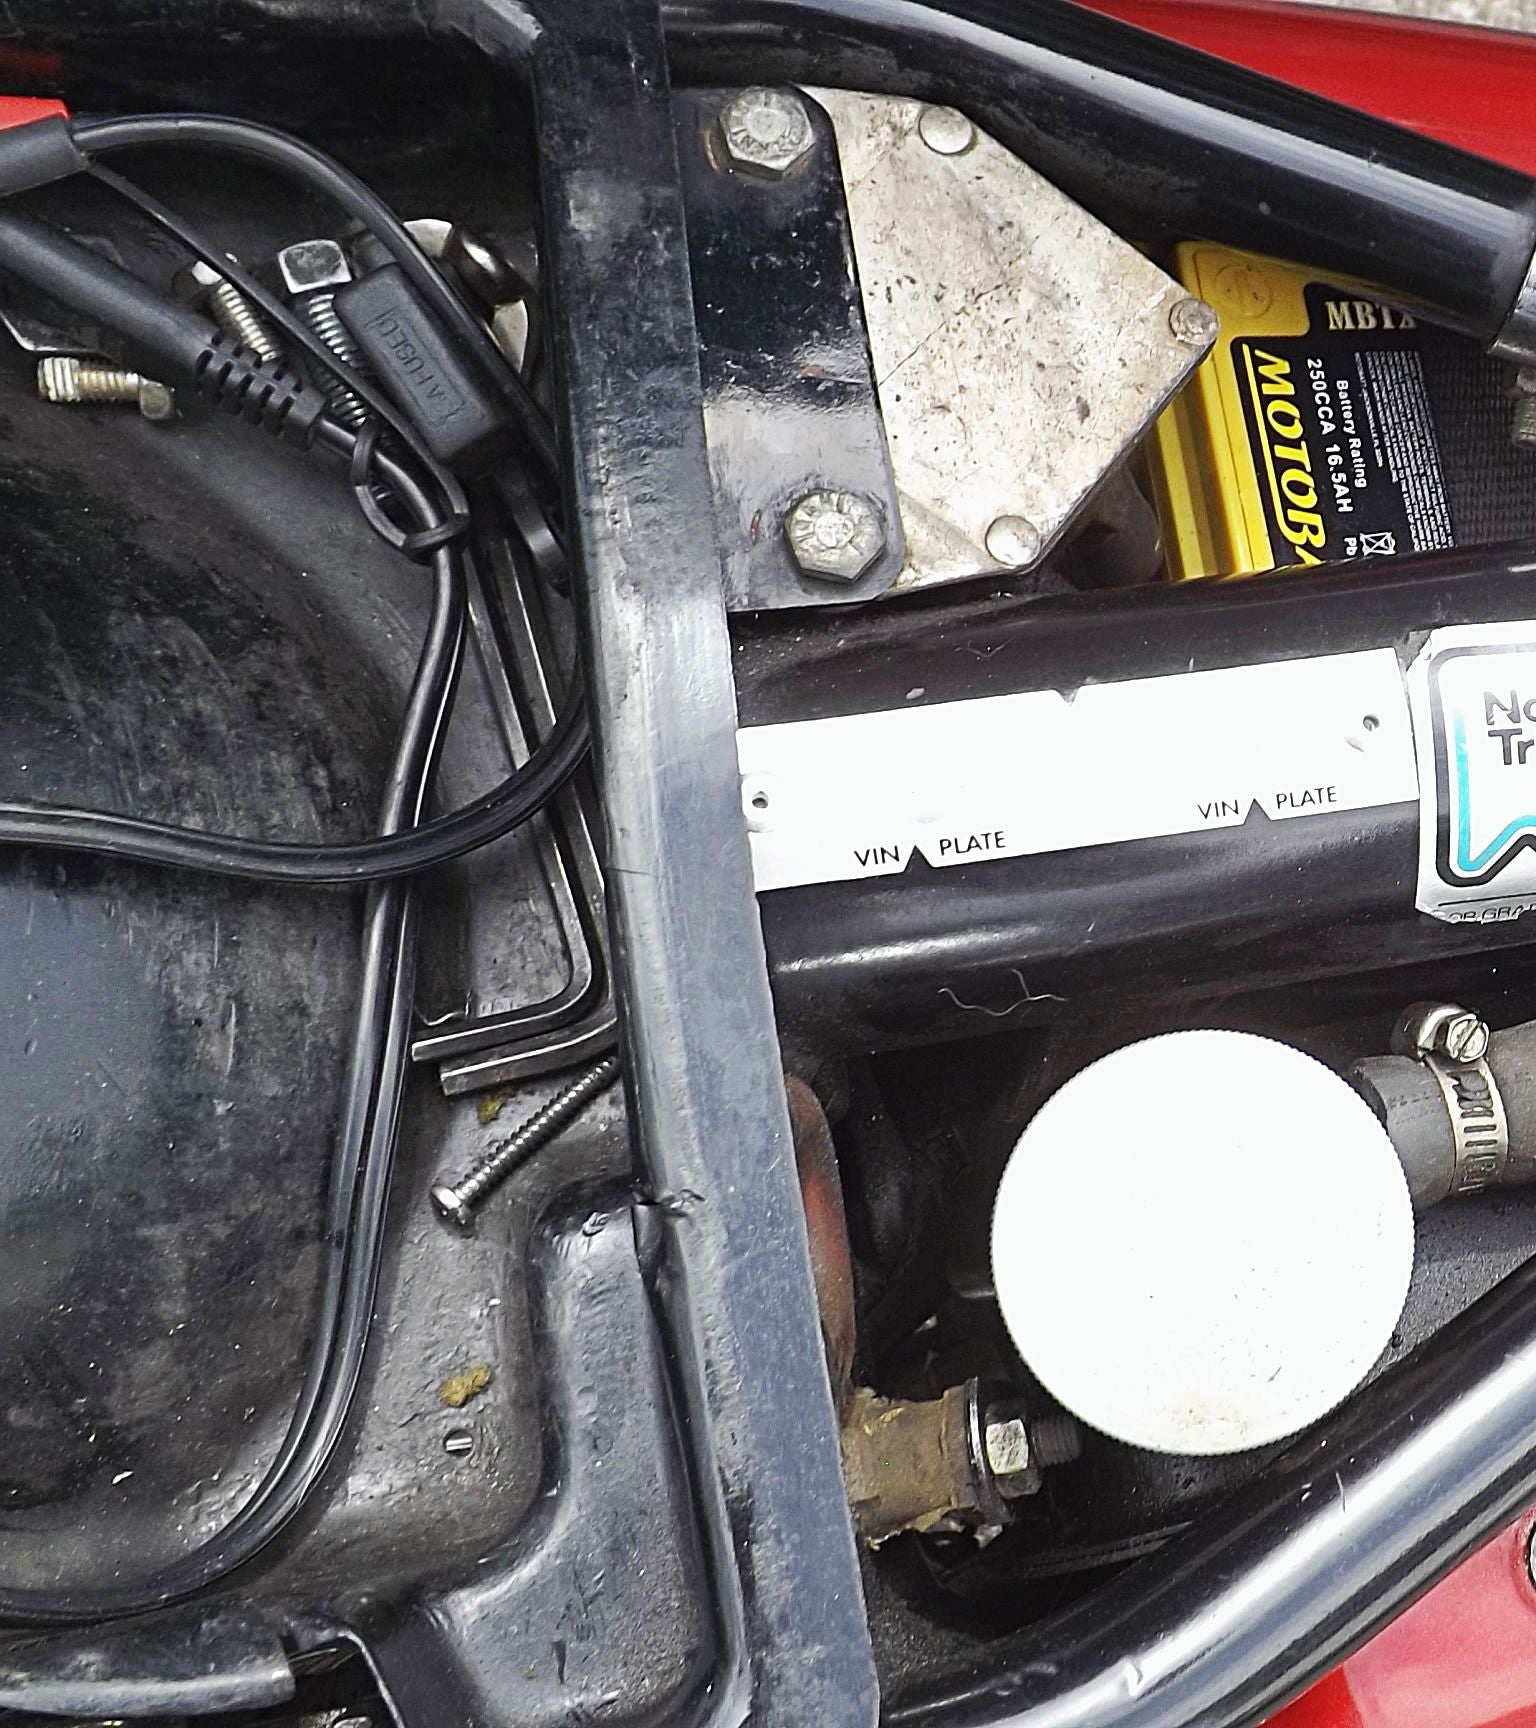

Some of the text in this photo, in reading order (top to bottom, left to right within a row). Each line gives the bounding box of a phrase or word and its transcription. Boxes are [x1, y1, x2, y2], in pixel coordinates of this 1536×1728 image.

[1307, 358, 1353, 513] 250CCA 16.5AH
[1336, 380, 1367, 488] Battery Rating
[1343, 538, 1357, 555] Pb
[1197, 786, 1338, 820] VIN PLATE
[854, 831, 1006, 867] VIN PLATE
